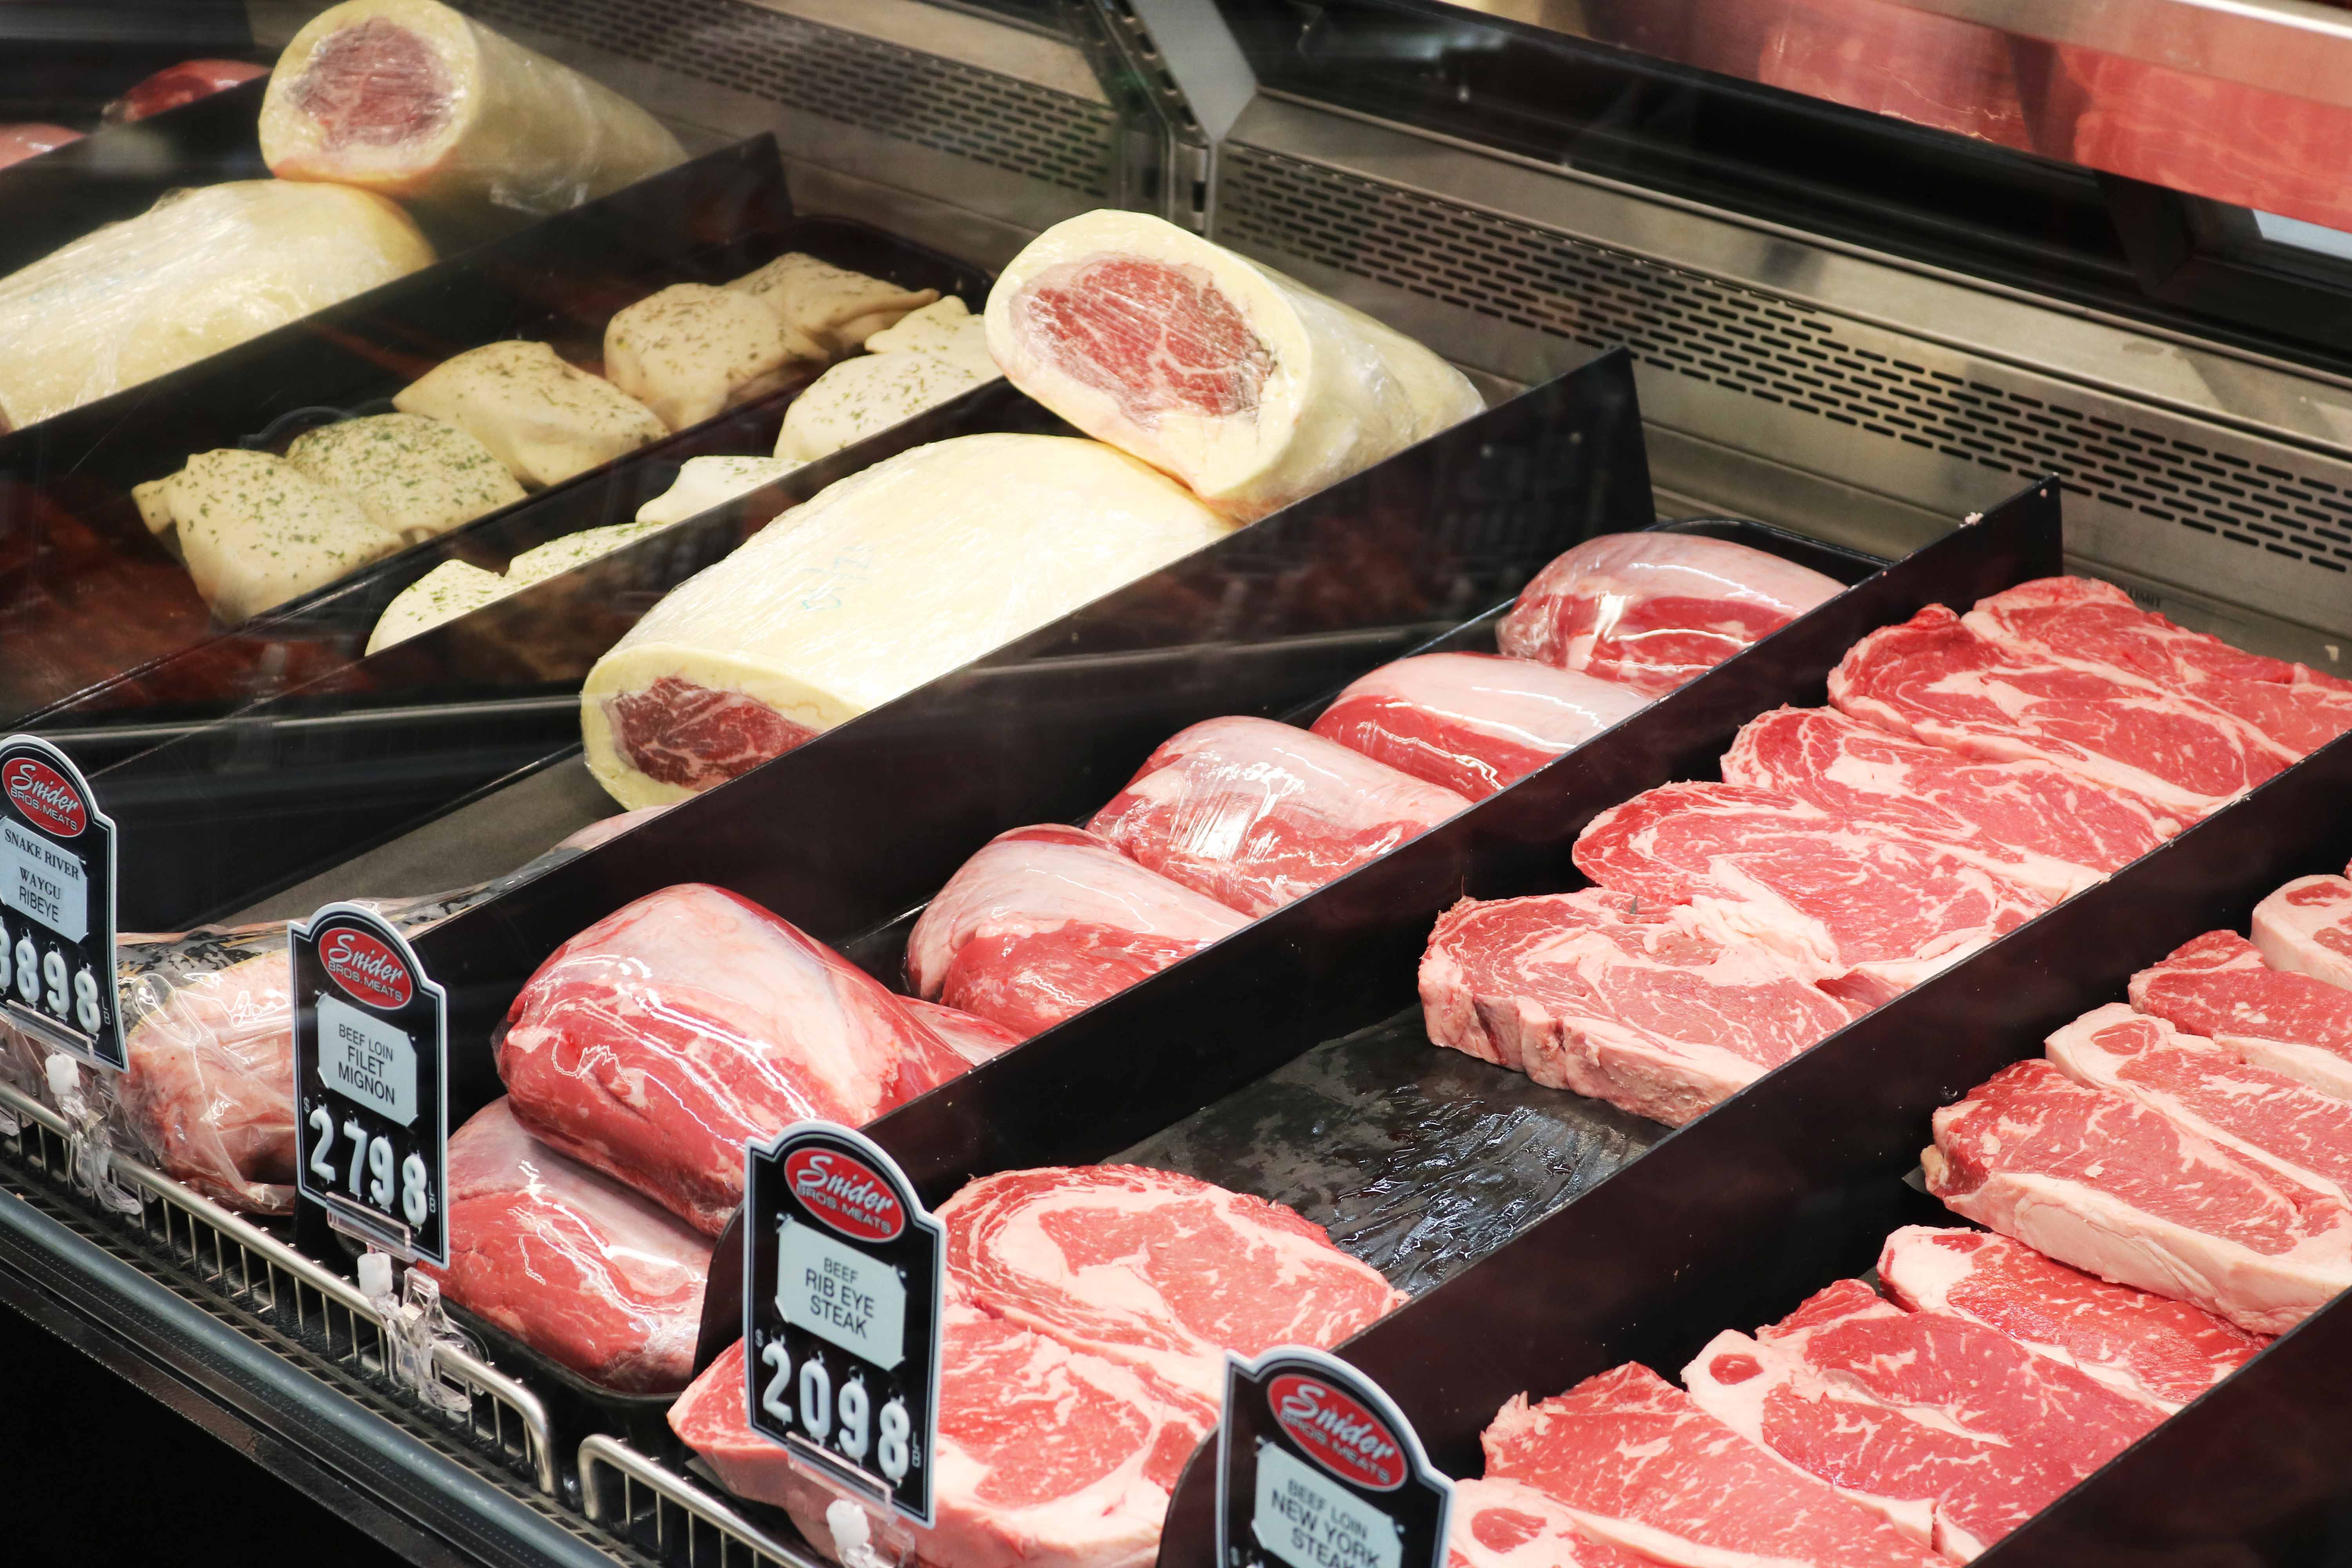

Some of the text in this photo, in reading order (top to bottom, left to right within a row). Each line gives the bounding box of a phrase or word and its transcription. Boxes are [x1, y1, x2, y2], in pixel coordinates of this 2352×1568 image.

[11, 764, 78, 813] Snider
[11, 787, 77, 831] BROS. MEATS
[5, 828, 79, 880] SNAKE RIVER
[19, 866, 61, 900] WAYGU
[19, 886, 59, 923] RIBEYE
[328, 934, 403, 984] Snider
[328, 962, 403, 1002] BROS. MEATS
[339, 1024, 393, 1062] BEEF LOIN
[348, 1045, 384, 1078] FILET
[338, 1062, 395, 1105] MIGNON
[797, 1155, 893, 1214] Snider
[841, 1203, 892, 1235] MEATS
[824, 1257, 858, 1284] BEEF
[806, 1269, 875, 1319] RIB EYE
[810, 1295, 868, 1339] STEAK
[1281, 1384, 1396, 1461] Snider
[1332, 1440, 1390, 1485] MEATS
[1271, 1490, 1381, 1568] NEW YORK
[1287, 1479, 1367, 1540] BEEF LOIN
